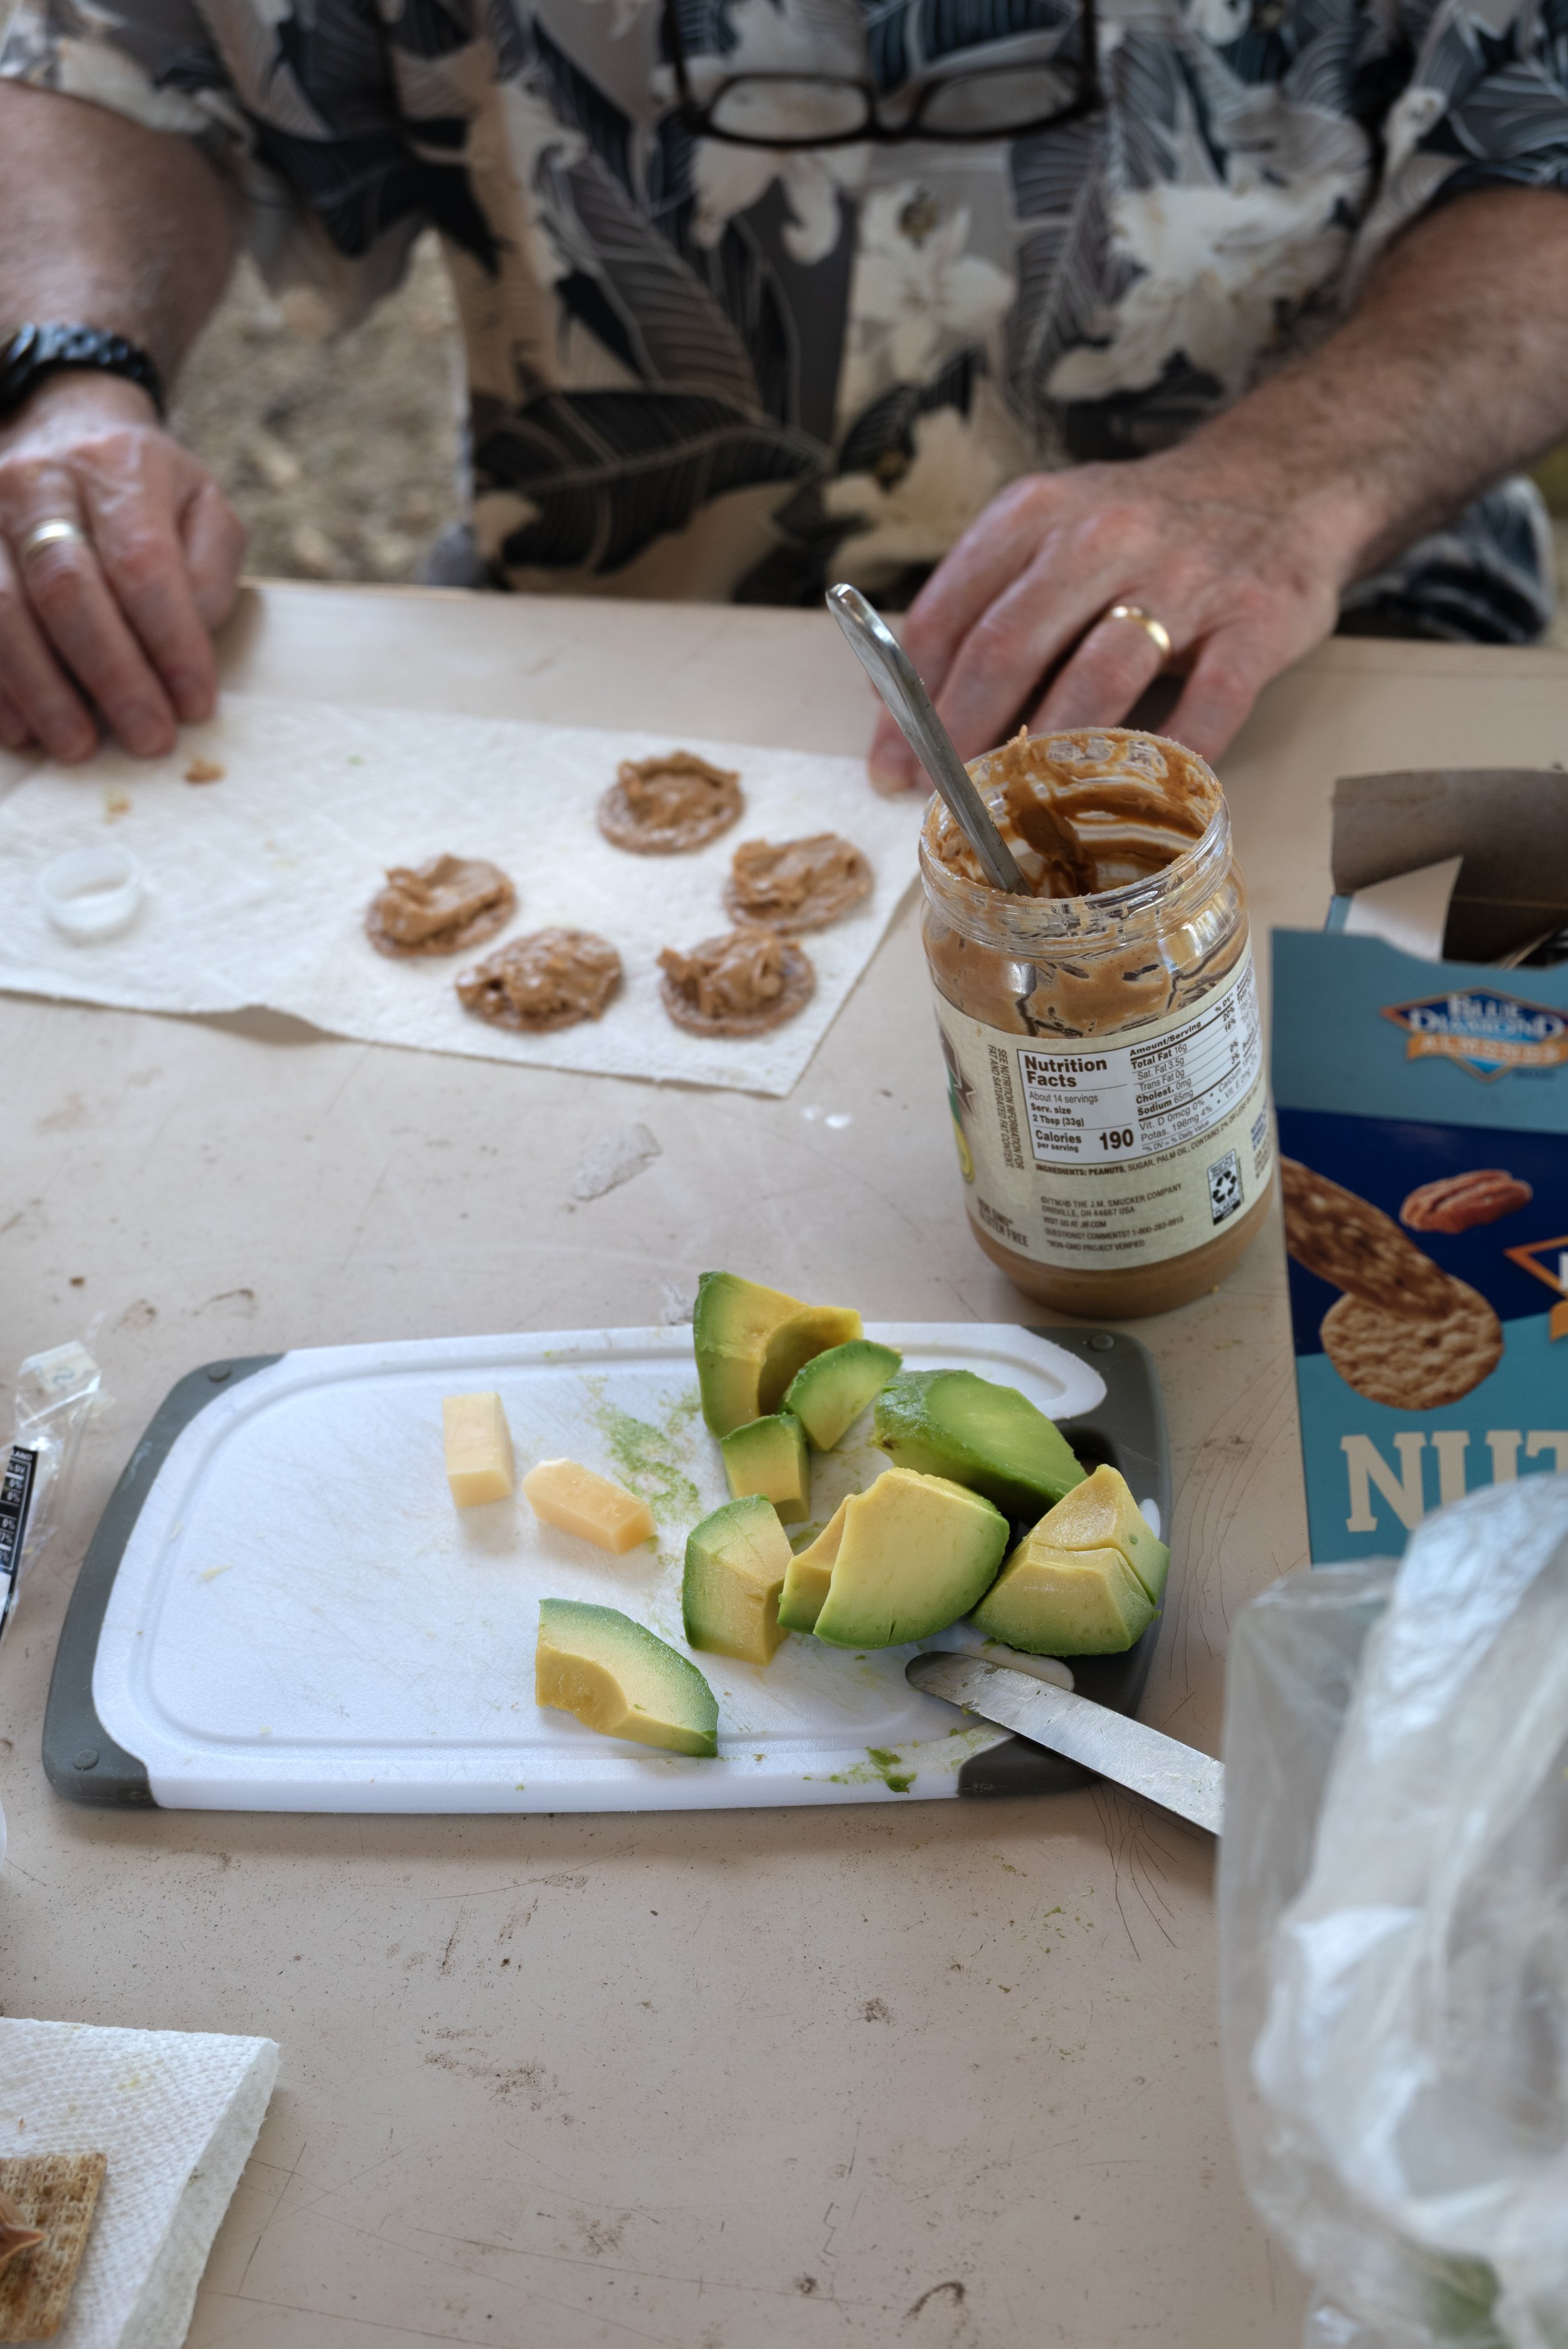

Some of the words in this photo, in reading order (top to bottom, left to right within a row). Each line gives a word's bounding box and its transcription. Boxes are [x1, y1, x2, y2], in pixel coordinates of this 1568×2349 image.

[1130, 1021, 1202, 1056] Amount/Serving
[1131, 1056, 1155, 1070] Total
[1158, 1049, 1172, 1061] Fat
[1175, 1043, 1187, 1054] 16g
[1223, 1006, 1235, 1022] 20%
[1138, 1069, 1153, 1081] Sat.
[1155, 1064, 1167, 1074] Fat
[1169, 1057, 1185, 1069] 3.5g
[1224, 1017, 1237, 1033] 16%
[988, 1044, 998, 1059] FAT
[998, 1048, 1009, 1064] SEE
[990, 1058, 1000, 1076] AND
[1024, 1055, 1108, 1073] Nutrition
[1136, 1086, 1175, 1105] Cholest.
[1176, 1078, 1191, 1090] 0mg
[1230, 1039, 1239, 1053] 0%
[1000, 1064, 1014, 1105] NUTRITION
[1026, 1071, 1077, 1087] Facts
[1140, 1079, 1161, 1092] Trans
[1162, 1074, 1174, 1084] Fat
[1175, 1069, 1185, 1080] 0g
[993, 1076, 1007, 1120] SATURATED
[1030, 1091, 1052, 1103] About
[1054, 1095, 1062, 1103] 14
[1065, 1094, 1099, 1105] servings
[1030, 1103, 1052, 1113] Serv.
[1054, 1106, 1072, 1114] size
[1137, 1099, 1173, 1116] Sodium
[1173, 1089, 1194, 1104] 65mg
[1139, 1120, 1155, 1131] Vit.
[1158, 1117, 1165, 1127] D
[1167, 1107, 1191, 1123] 0mcg
[1192, 1098, 1205, 1111] 0%
[1219, 1066, 1242, 1093] Calcium
[999, 1119, 1009, 1133] FAT
[1006, 1104, 1022, 1154] INFORMATION
[1040, 1115, 1061, 1127] Tbsp
[1062, 1117, 1084, 1127] (33g)
[1141, 1129, 1170, 1142] Potas.
[1172, 1113, 1200, 1132] 196mg
[1201, 1105, 1213, 1116] 4%
[1036, 1130, 1082, 1143] Calories
[1099, 1129, 1134, 1150] 190
[1153, 1142, 1164, 1150] DV
[1179, 1130, 1194, 1141] Daily
[1194, 1121, 1210, 1132] Value
[1036, 1163, 1087, 1176] INGREDIENTS:
[1088, 1165, 1126, 1176] PEANUTS,
[1128, 1159, 1155, 1172] SUGAR,
[1157, 1151, 1177, 1164] PALM
[1177, 1147, 1190, 1157] OIL,
[1191, 1127, 1221, 1150] CONTAINS
[1051, 1143, 1079, 1153] serving
[1014, 1153, 1024, 1170] FOR
[1108, 1194, 1145, 1207] SMUCKER
[1147, 1183, 1182, 1201] COMPANY
[1119, 1206, 1136, 1215] USA
